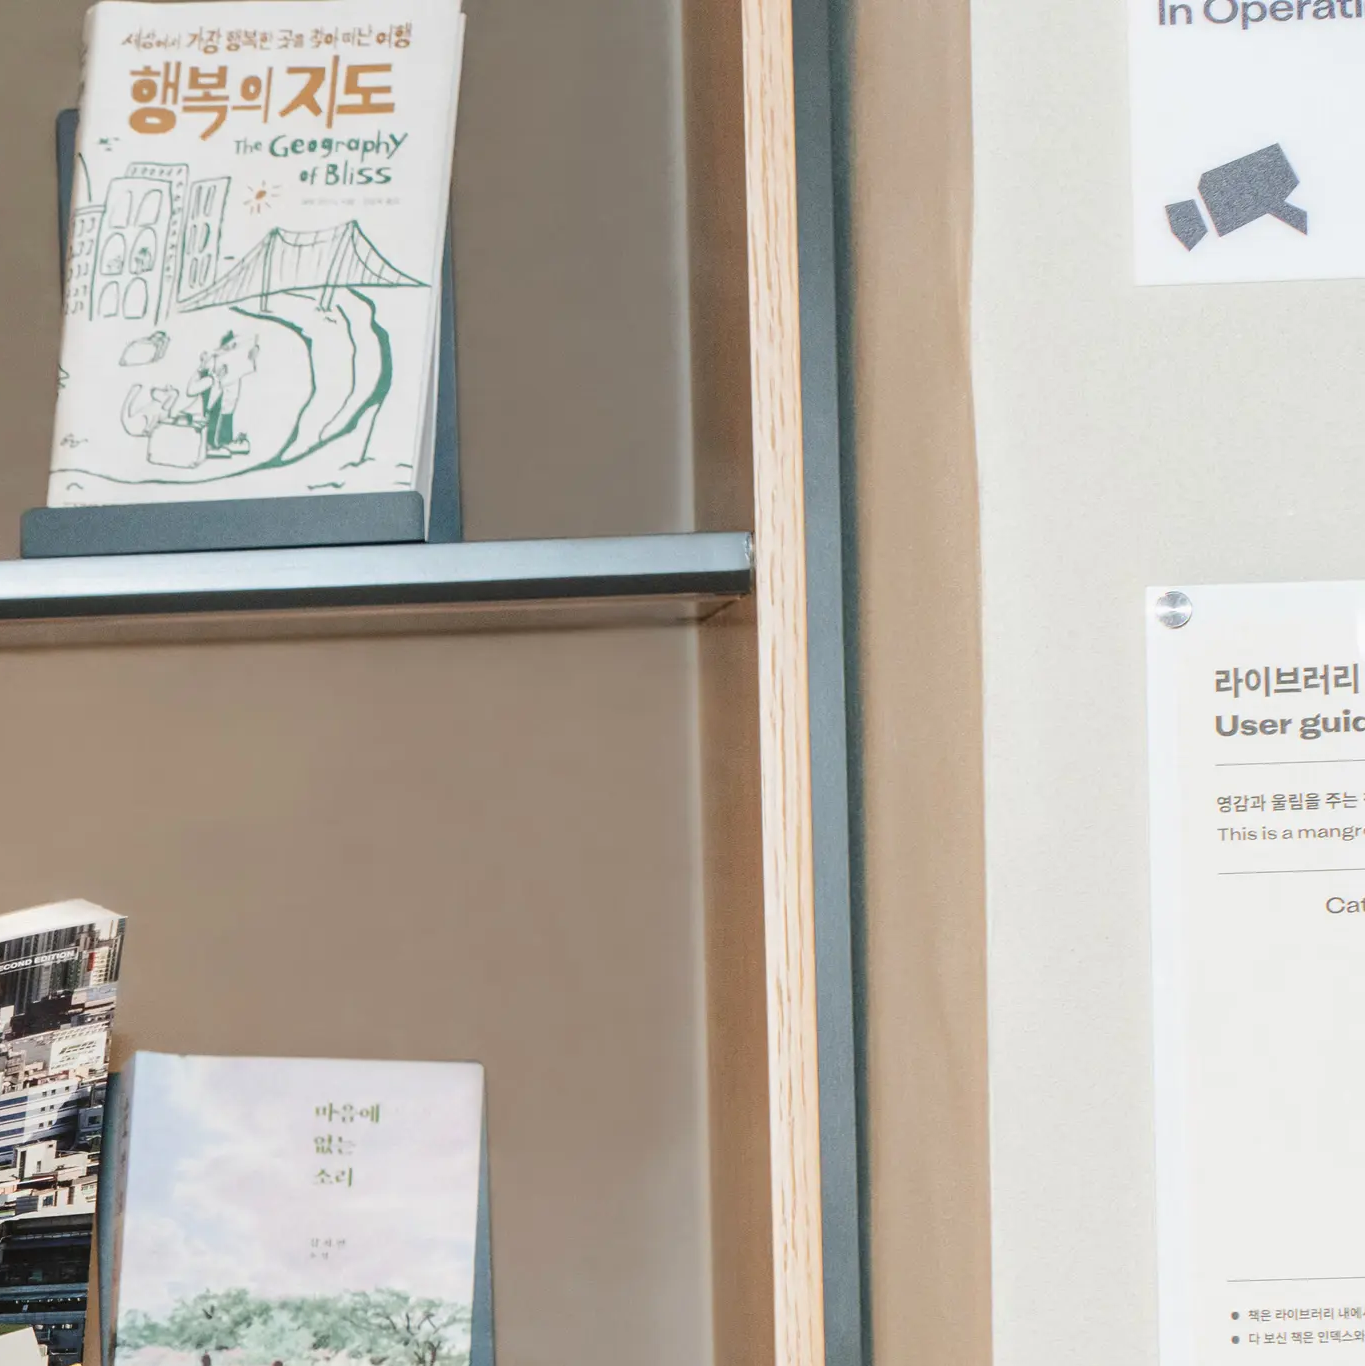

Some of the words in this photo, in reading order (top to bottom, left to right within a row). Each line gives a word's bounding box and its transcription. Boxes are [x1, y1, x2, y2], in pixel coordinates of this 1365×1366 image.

[1158, 0, 1193, 25] In
[120, 25, 182, 51] 세상에서
[187, 26, 221, 54] 가장
[226, 27, 272, 52] 행복한
[309, 25, 339, 49] 찾아
[375, 22, 414, 48] 여행
[128, 61, 274, 142] 행복의
[278, 55, 396, 129] 지도
[234, 138, 263, 155] The
[268, 130, 409, 163] Geography
[299, 165, 318, 185] of
[325, 161, 393, 187] Bliss
[1214, 663, 1360, 698] 라이브러리
[1214, 714, 1292, 737] User
[1216, 793, 1266, 813] 영감과
[1270, 792, 1321, 812] 울림을
[1324, 791, 1358, 810] 주는
[1217, 826, 1258, 842] This
[1262, 826, 1278, 841] is
[1281, 828, 1293, 840] a
[1297, 823, 1365, 842] mangr
[33, 949, 75, 964] EDITION
[314, 1100, 382, 1125] 마음에
[313, 1132, 357, 1156] 없는
[312, 1166, 355, 1188] 소리
[1248, 1308, 1271, 1322] 책은
[1275, 1307, 1335, 1322] 라이브러리
[1249, 1333, 1260, 1345] 다
[1263, 1331, 1287, 1345] 보신
[1290, 1331, 1314, 1344] 책은
